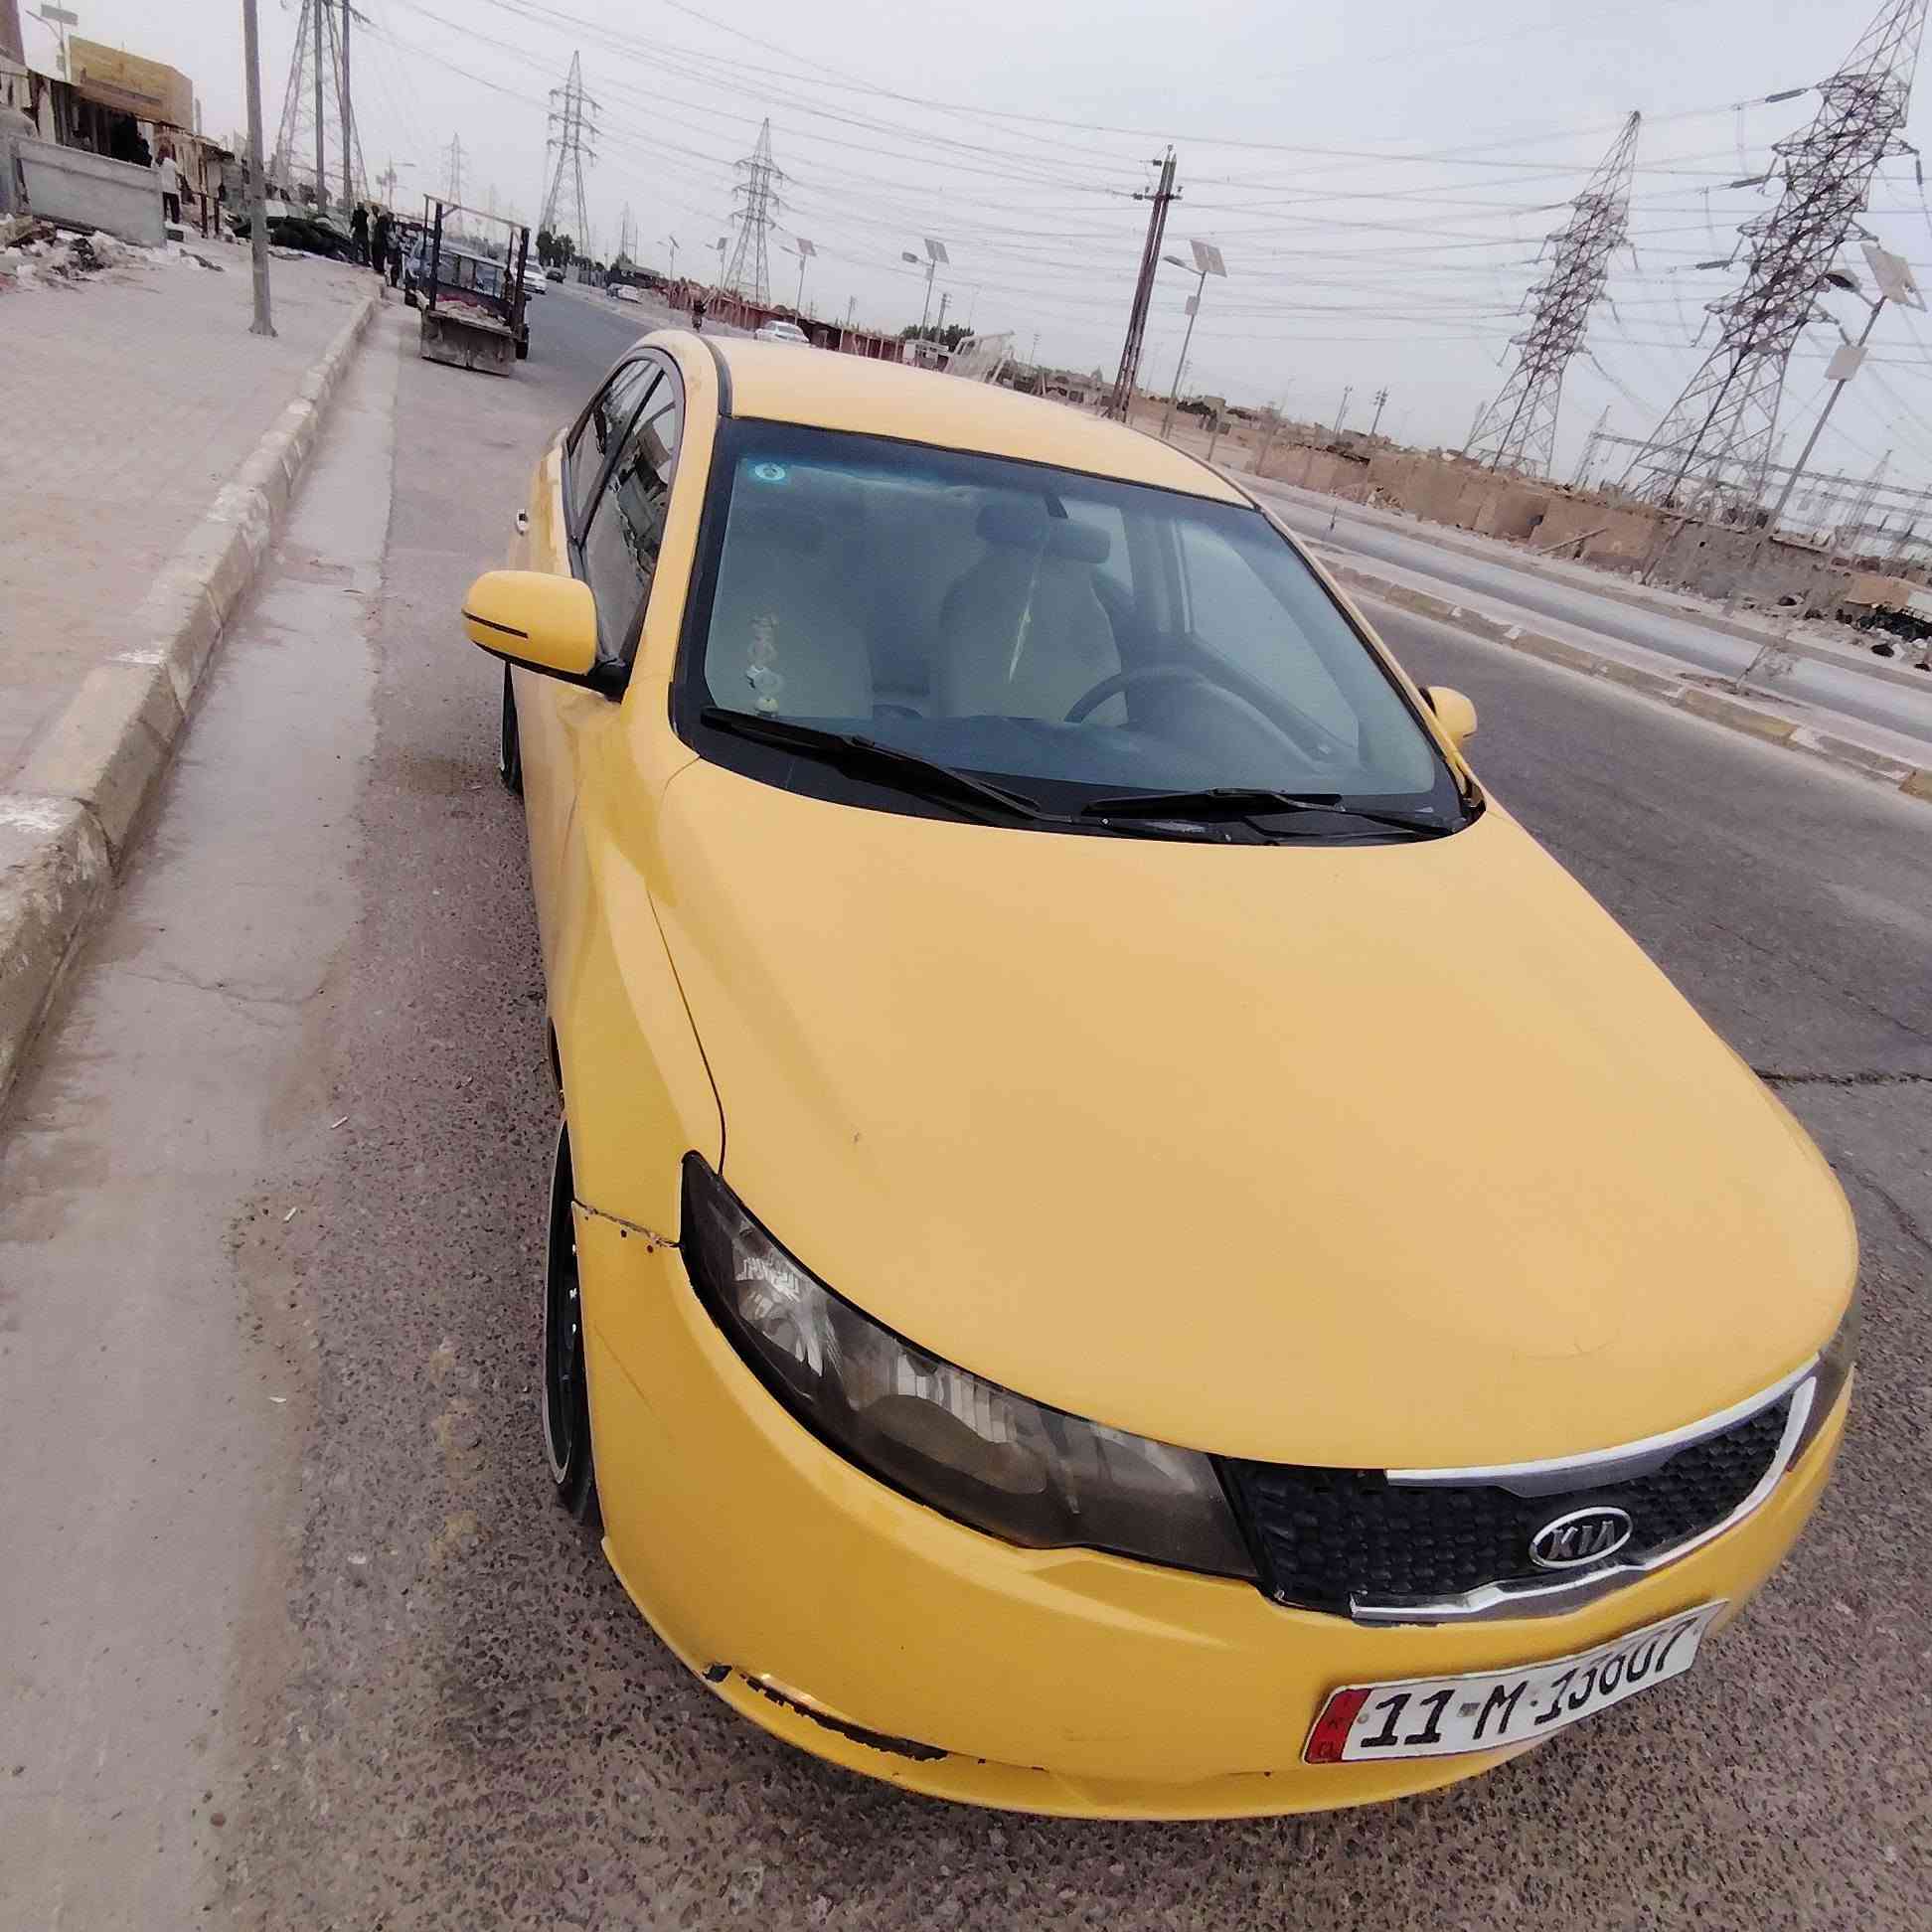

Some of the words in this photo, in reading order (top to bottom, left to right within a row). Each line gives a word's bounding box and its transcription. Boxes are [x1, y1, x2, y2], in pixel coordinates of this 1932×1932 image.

[1546, 1520, 1615, 1560] KIA
[1361, 1690, 1455, 1747] 11
[1473, 1681, 1529, 1739] M
